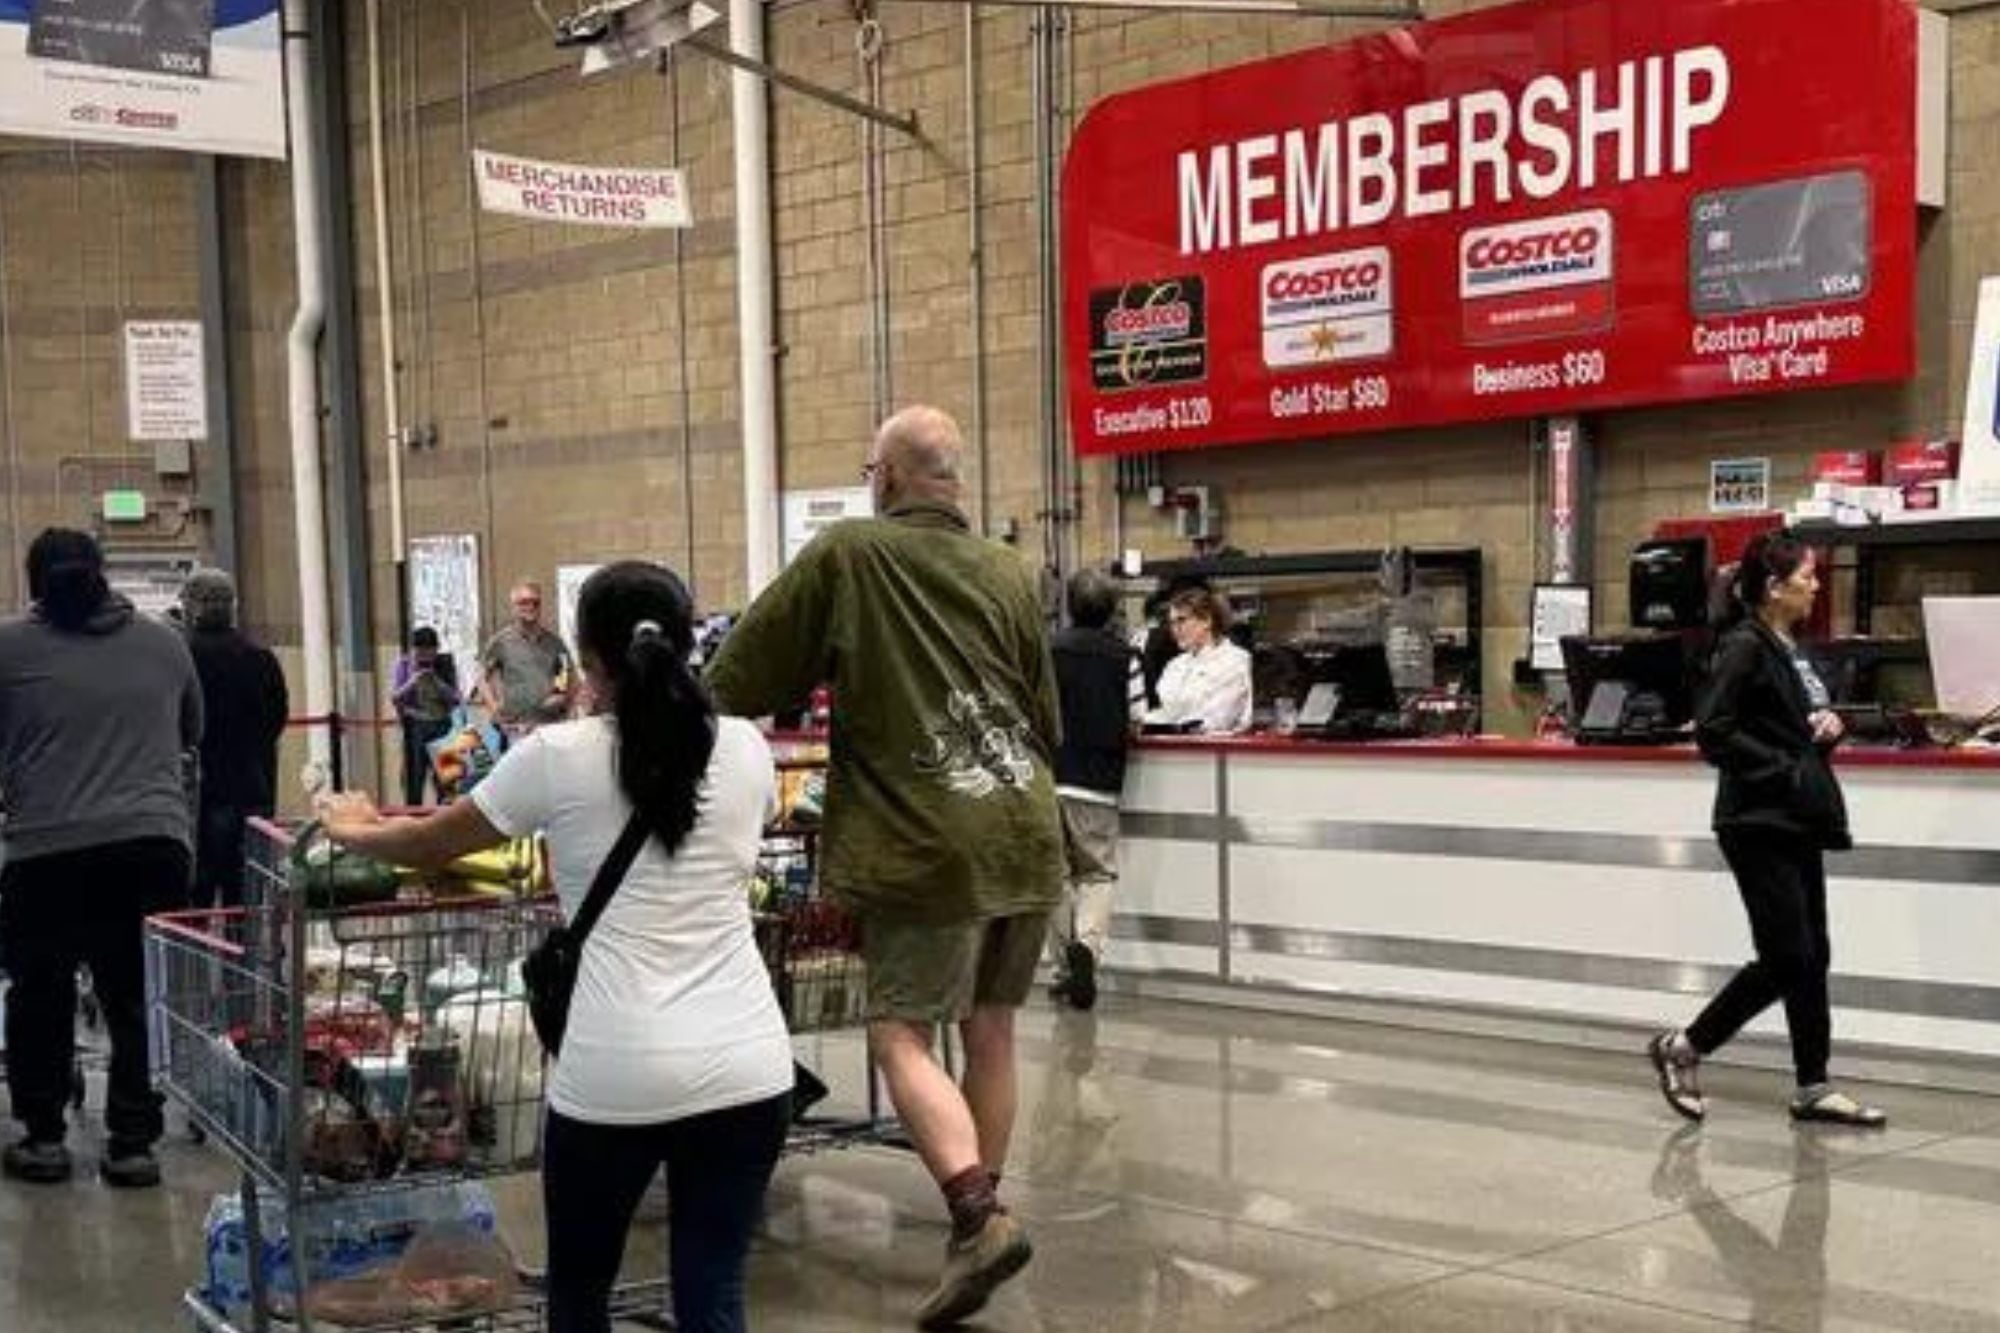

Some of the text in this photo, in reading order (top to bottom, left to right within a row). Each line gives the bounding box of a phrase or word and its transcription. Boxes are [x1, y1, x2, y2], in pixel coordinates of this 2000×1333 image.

[1178, 45, 1730, 256] MEMBERSHIP
[484, 156, 676, 198] MERCHANDISE
[521, 189, 646, 220] RETURNS
[1466, 226, 1600, 270] COSTCO
[1266, 262, 1382, 300] COSTCO
[1820, 275, 1862, 295] VISA
[1692, 311, 1865, 355] Costco Anywhere
[1473, 350, 1606, 397] Business $60
[1780, 346, 1828, 379] Card
[1094, 395, 1213, 436] Executive $120
[1270, 385, 1310, 419] Gold
[1312, 381, 1350, 414] Star
